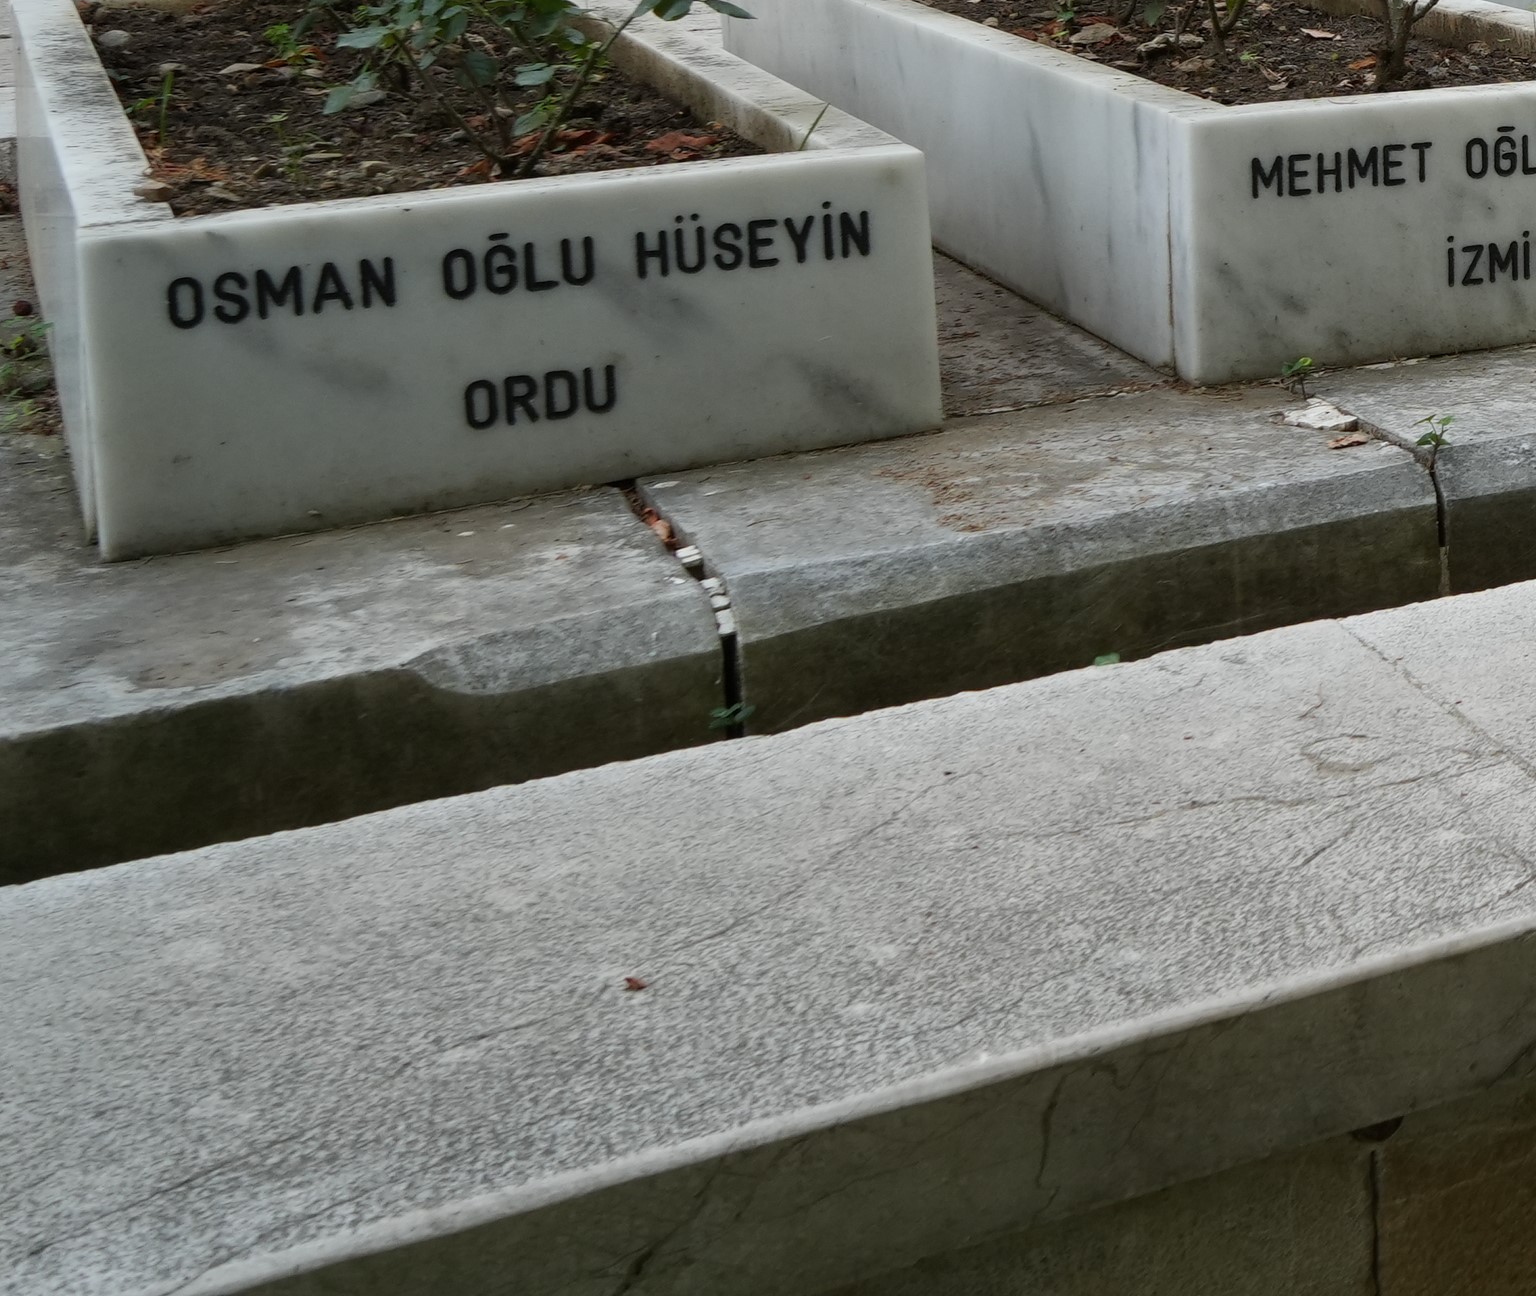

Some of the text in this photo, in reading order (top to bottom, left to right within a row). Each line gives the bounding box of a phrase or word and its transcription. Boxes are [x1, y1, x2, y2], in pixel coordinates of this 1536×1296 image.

[1251, 141, 1432, 199] MEHMET
[167, 202, 872, 329] OSMAN OĞLU HÜSEYİN
[464, 364, 617, 430] ORDU
